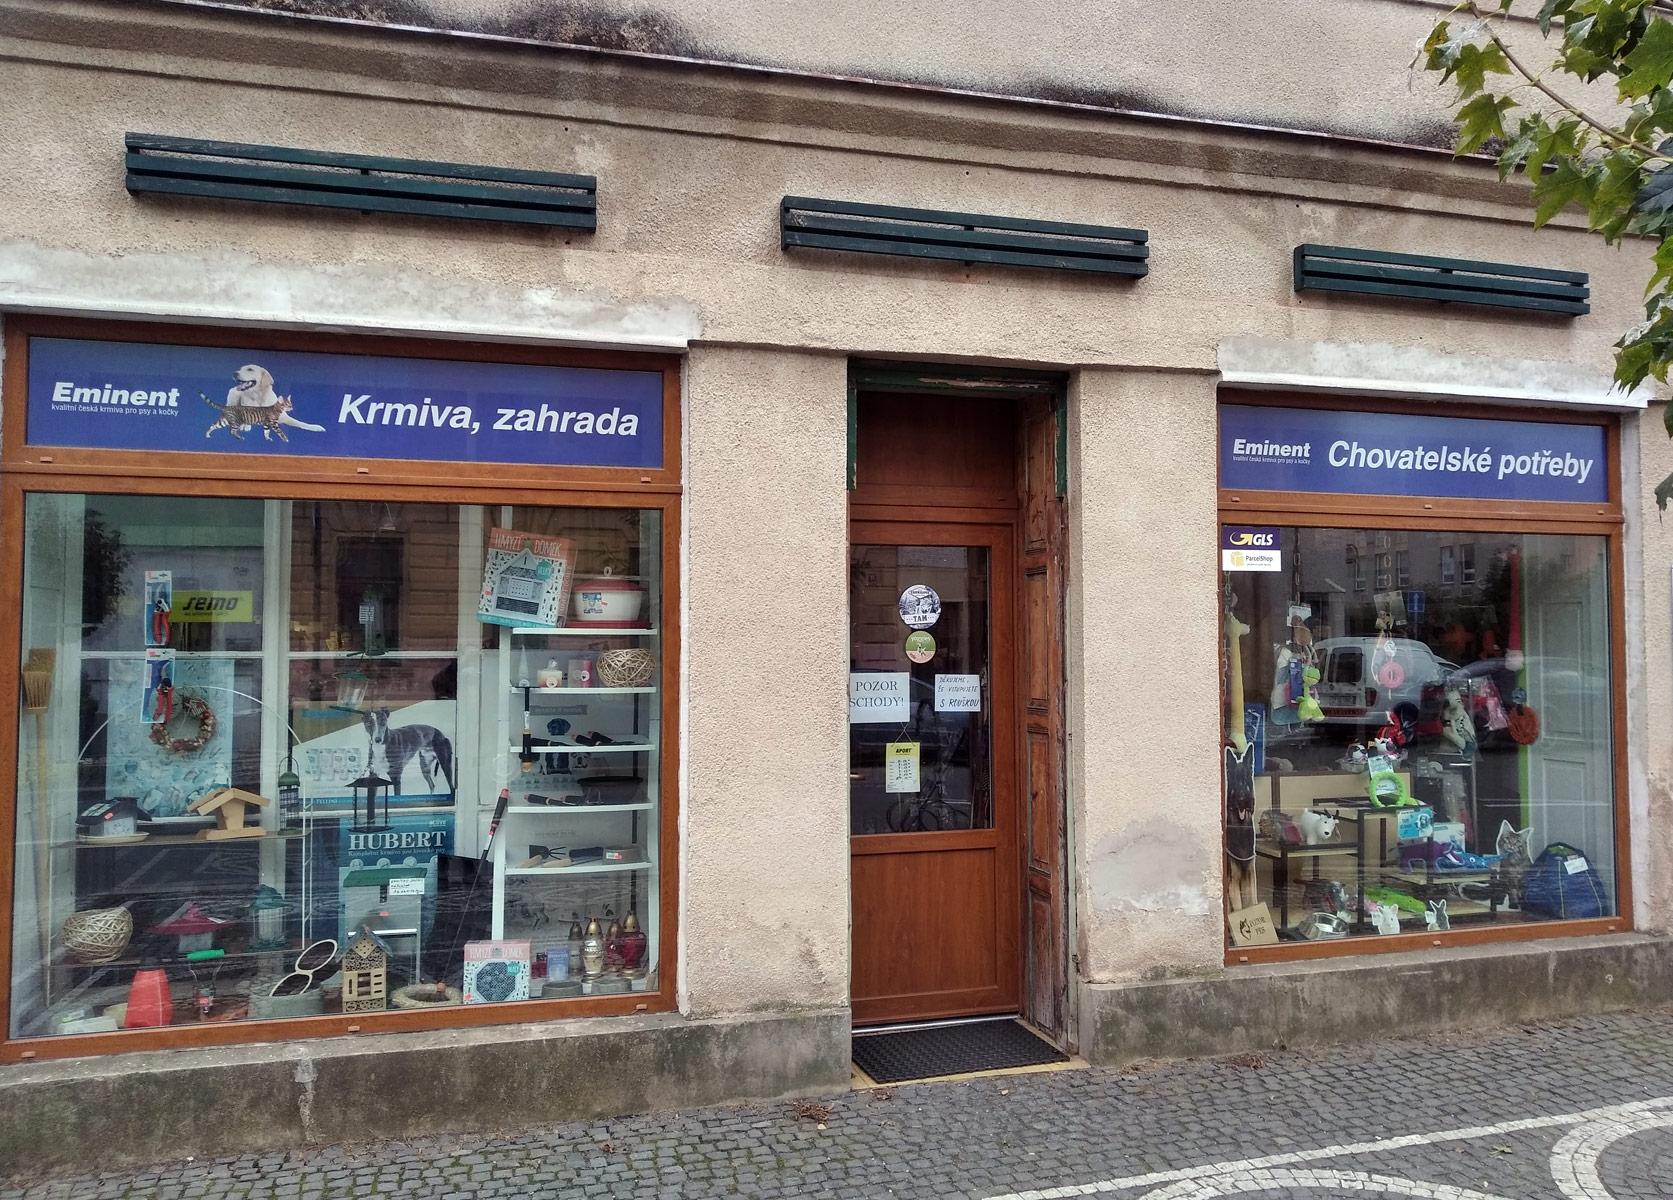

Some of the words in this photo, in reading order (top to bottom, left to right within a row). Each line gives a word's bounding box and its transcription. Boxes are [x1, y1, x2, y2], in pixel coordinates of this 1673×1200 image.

[52, 381, 180, 407] Eminent
[51, 403, 77, 412] kvalitní
[78, 404, 98, 412] česká
[99, 405, 124, 414] krmiva
[138, 408, 151, 416] psy
[158, 408, 179, 417] kočky
[338, 394, 481, 434] Krmiva,
[492, 403, 639, 436] zahrada
[1233, 438, 1311, 457] Eminent
[1328, 440, 1492, 473] Chovatelské
[1498, 450, 1594, 484] potřeby
[1253, 533, 1274, 546] GLS
[855, 680, 898, 692] POZOR
[849, 696, 904, 708] SCHODY!
[940, 699, 945, 708] S
[948, 696, 980, 708] ROUŠKOU
[348, 831, 447, 850] HUBERT
